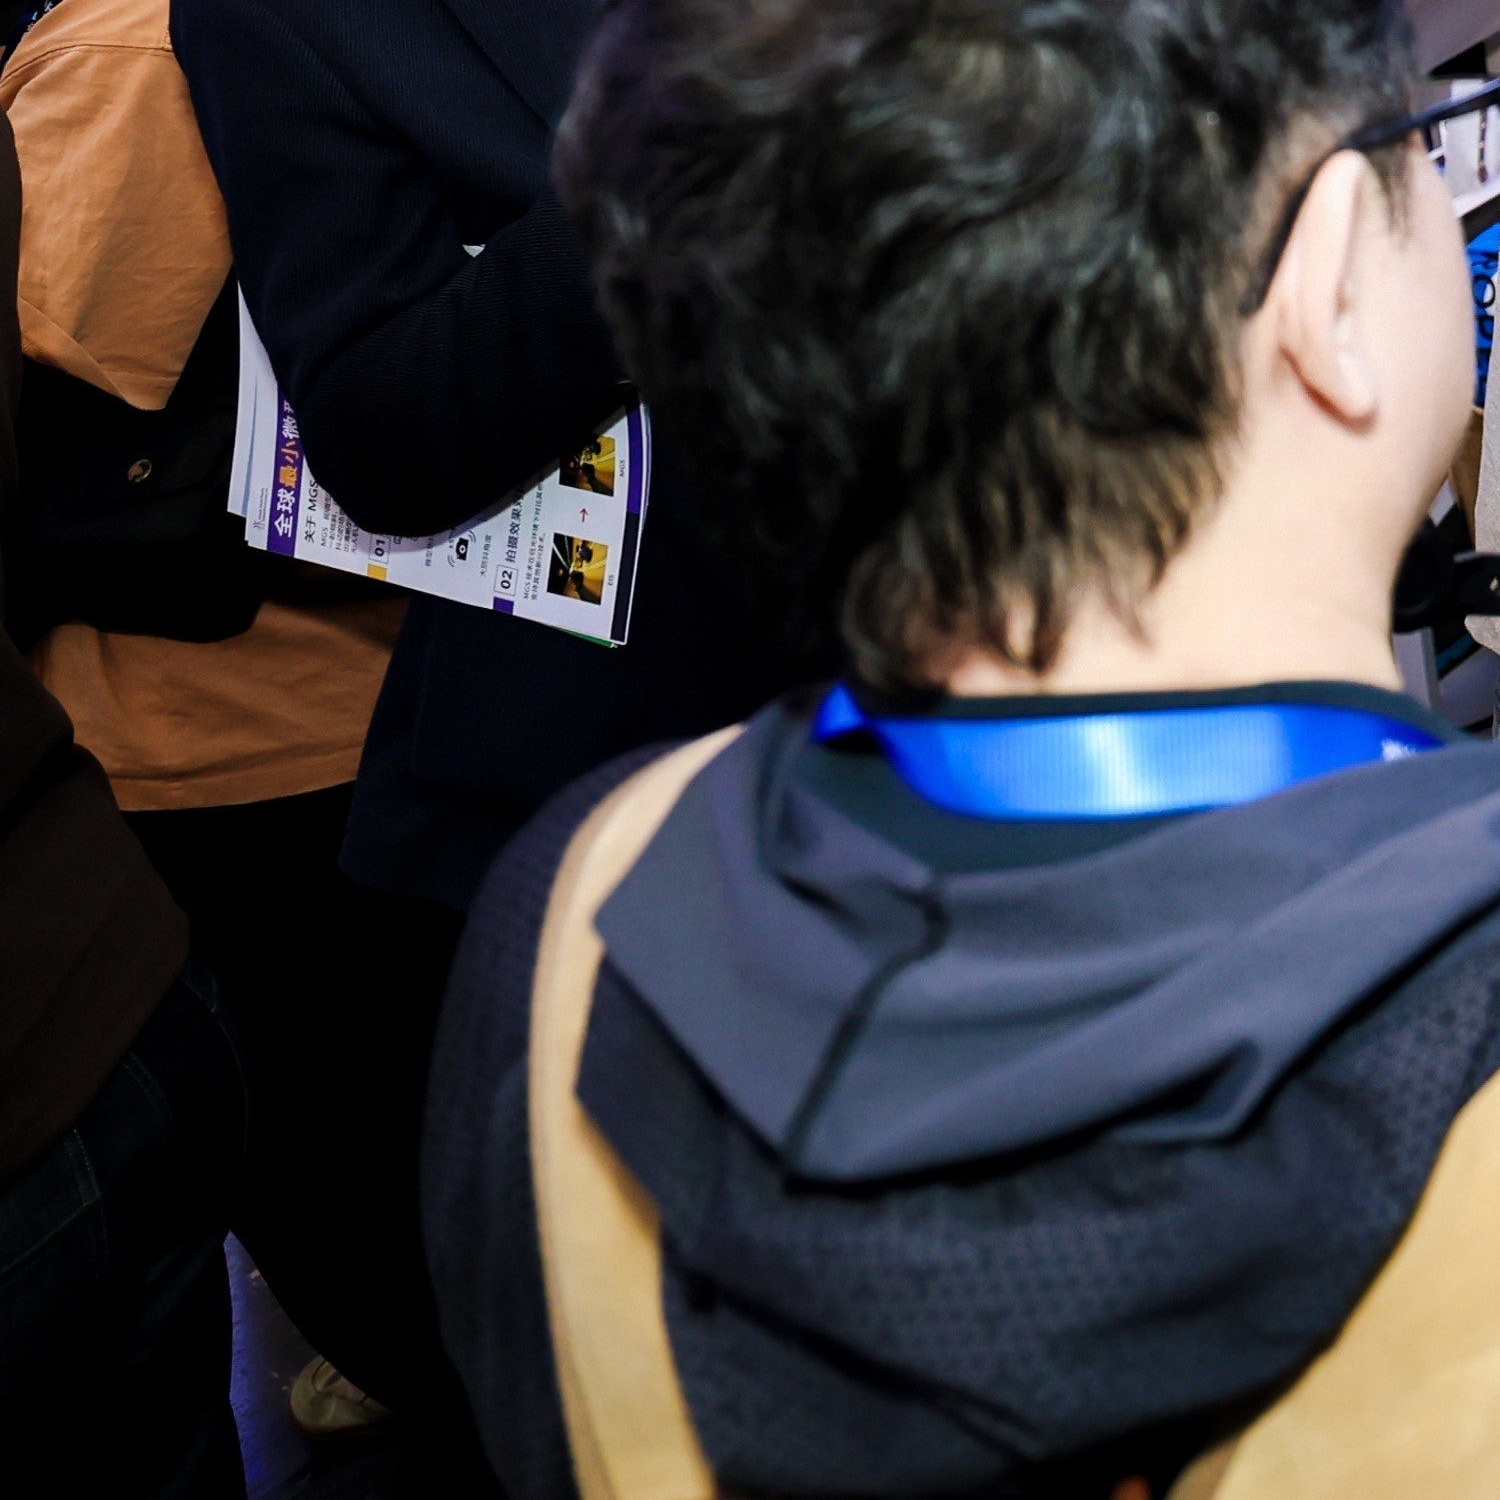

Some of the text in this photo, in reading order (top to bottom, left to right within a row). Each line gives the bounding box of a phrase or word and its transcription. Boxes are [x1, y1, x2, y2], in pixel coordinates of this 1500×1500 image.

[303, 479, 319, 543] 关于 MGS
[499, 494, 523, 591] 02 拍摄效果对
[373, 536, 386, 558] 01
